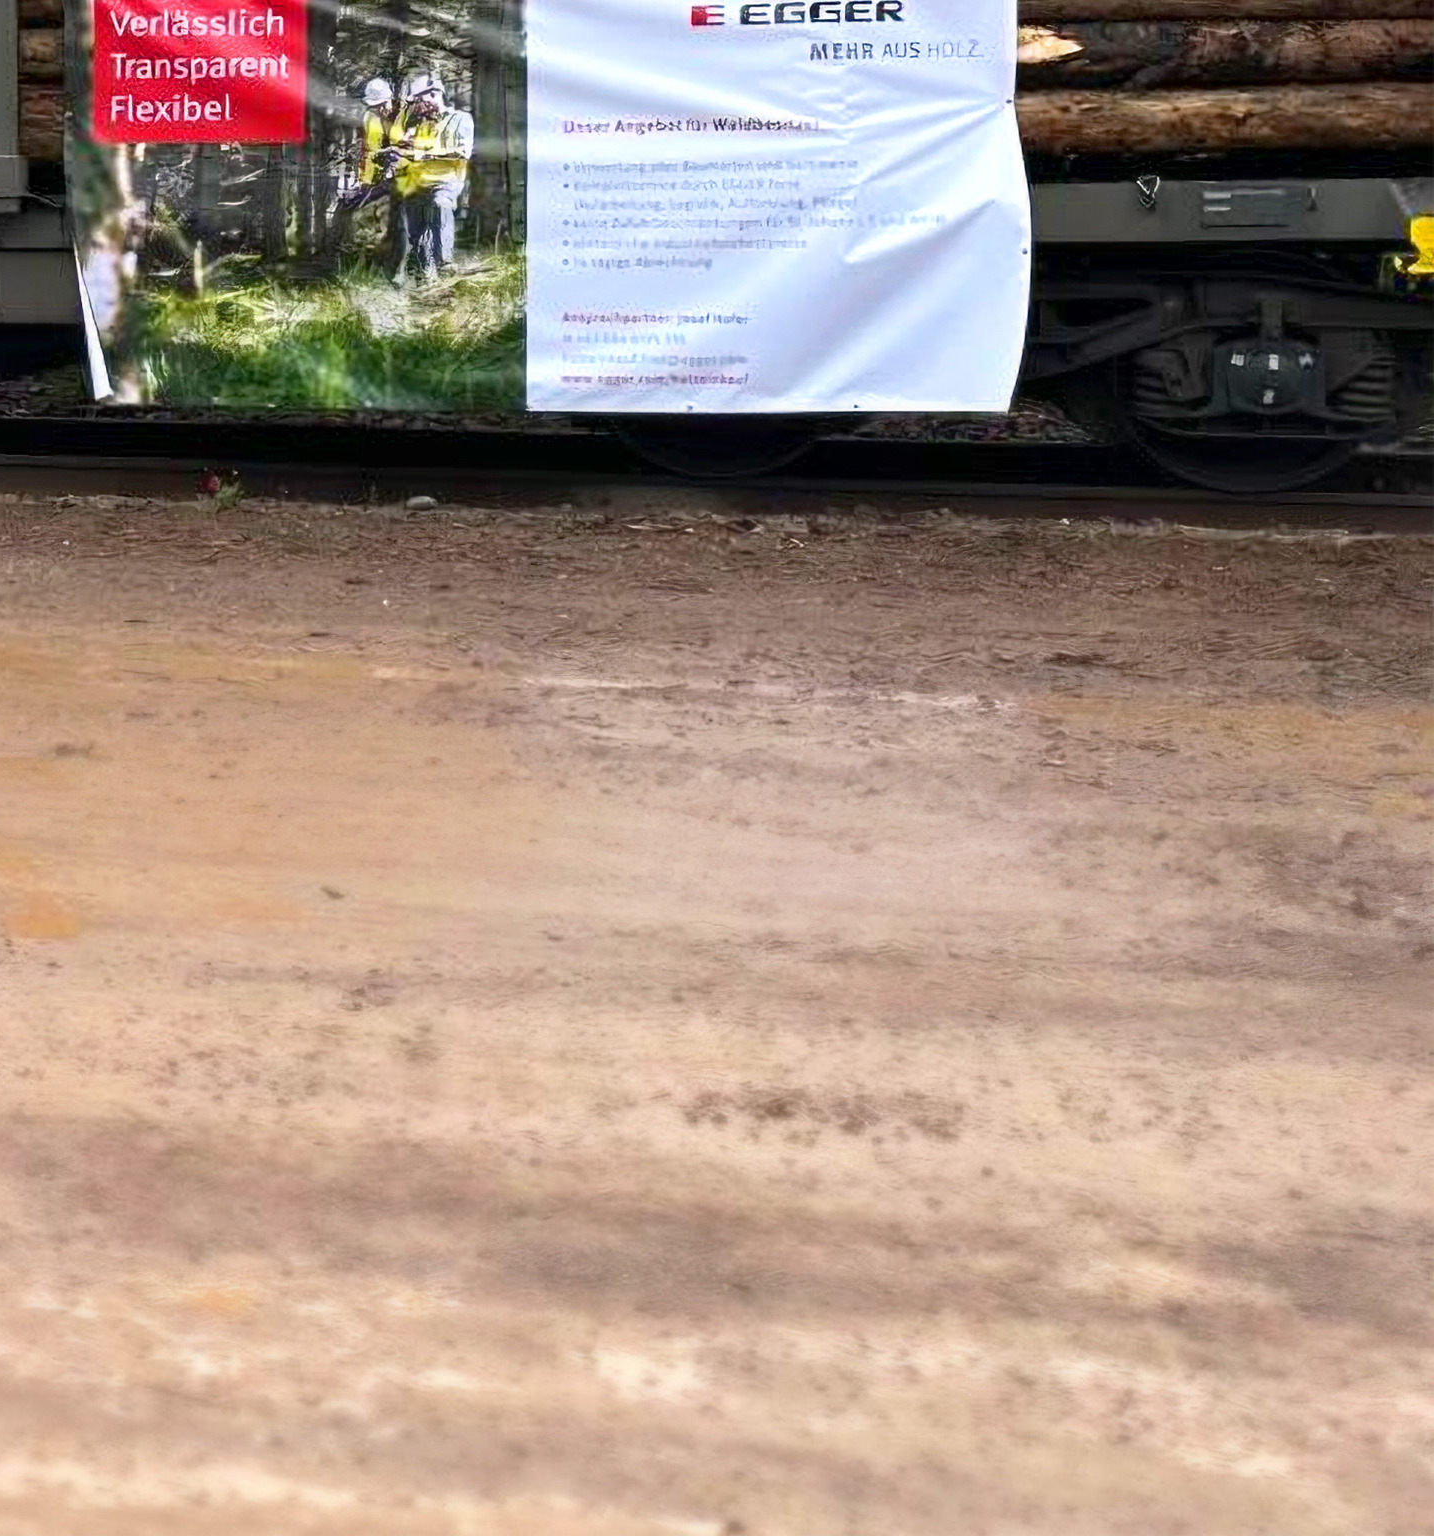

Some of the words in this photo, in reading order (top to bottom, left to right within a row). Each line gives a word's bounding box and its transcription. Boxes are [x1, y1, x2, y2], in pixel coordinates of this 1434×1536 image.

[109, 8, 285, 38] Verlässlich
[738, 0, 905, 26] EGGER
[810, 42, 874, 62] MEHR
[881, 40, 921, 60] AUS
[927, 38, 983, 59] HOLZ
[109, 53, 290, 85] Transparent
[110, 92, 233, 123] Flexibel
